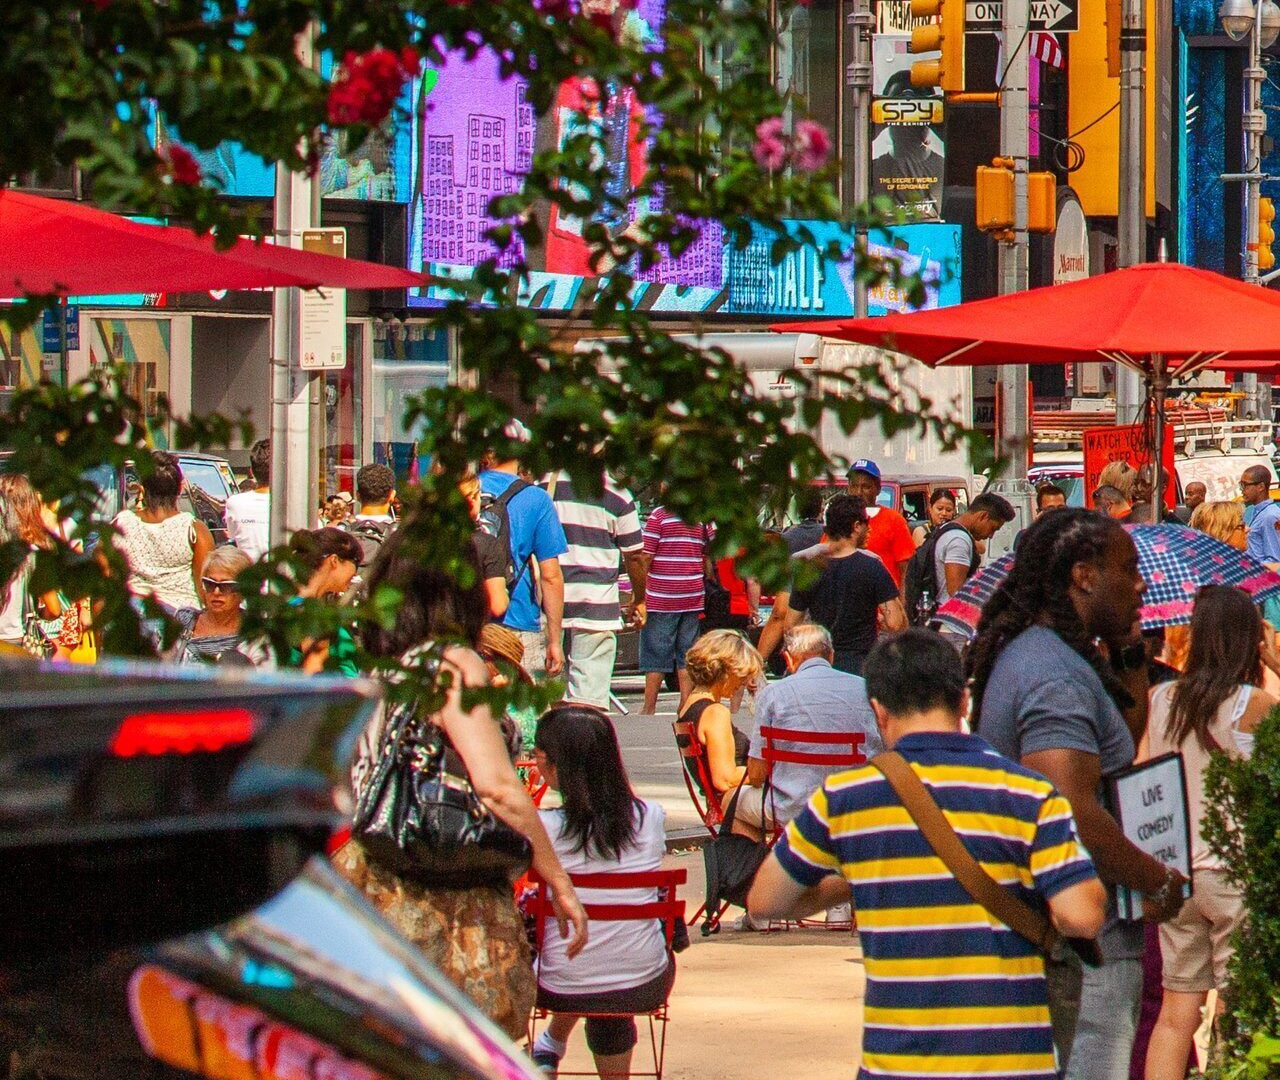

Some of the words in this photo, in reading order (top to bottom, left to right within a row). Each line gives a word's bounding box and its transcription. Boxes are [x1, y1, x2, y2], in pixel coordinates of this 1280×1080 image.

[882, 102, 934, 121] SPY
[1141, 784, 1165, 808] LIVE
[1136, 813, 1175, 842] COMEDY
